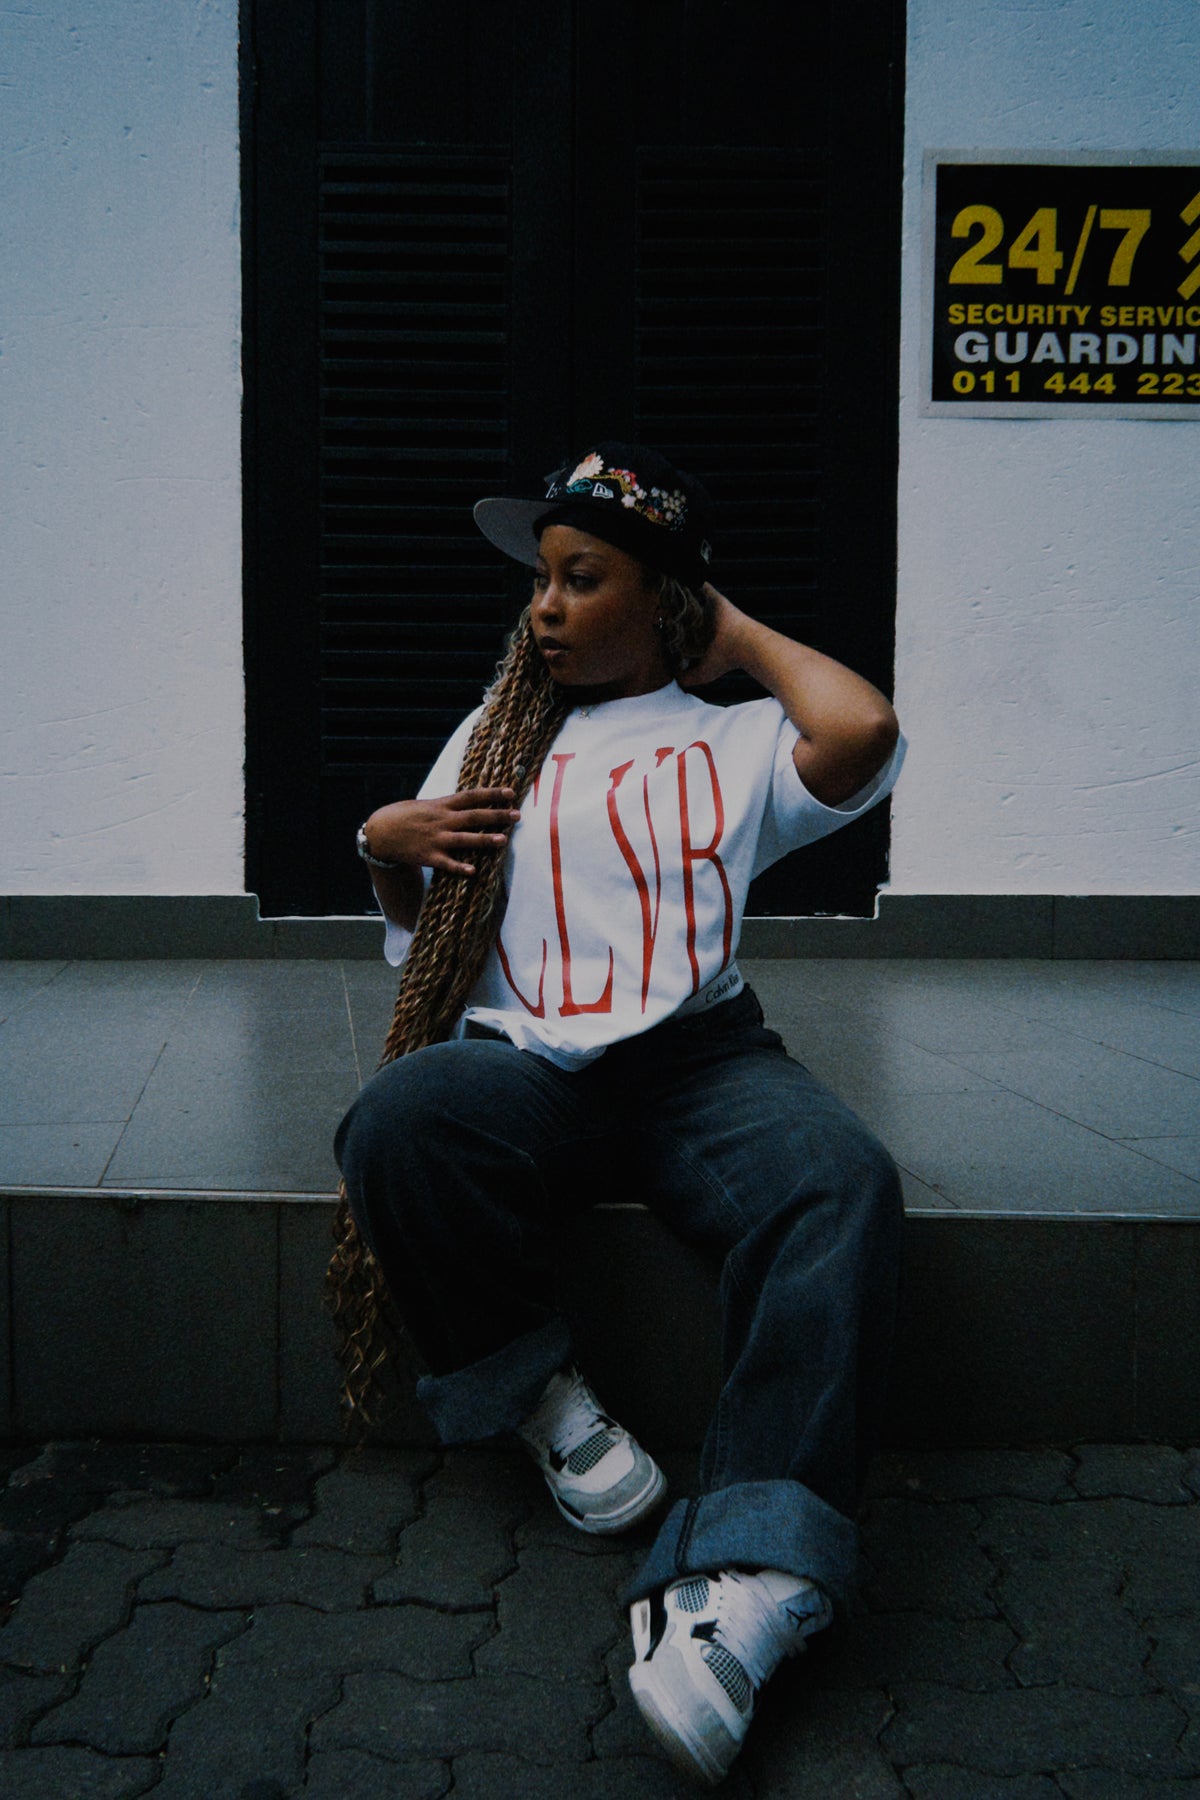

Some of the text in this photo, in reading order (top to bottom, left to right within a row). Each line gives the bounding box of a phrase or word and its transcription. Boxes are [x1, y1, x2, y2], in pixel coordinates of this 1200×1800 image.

[948, 203, 1153, 297] 24/7
[947, 303, 1092, 326] SECURITY
[953, 330, 1200, 366] GUARDIN
[951, 370, 1022, 394] 011
[1043, 371, 1117, 395] 444
